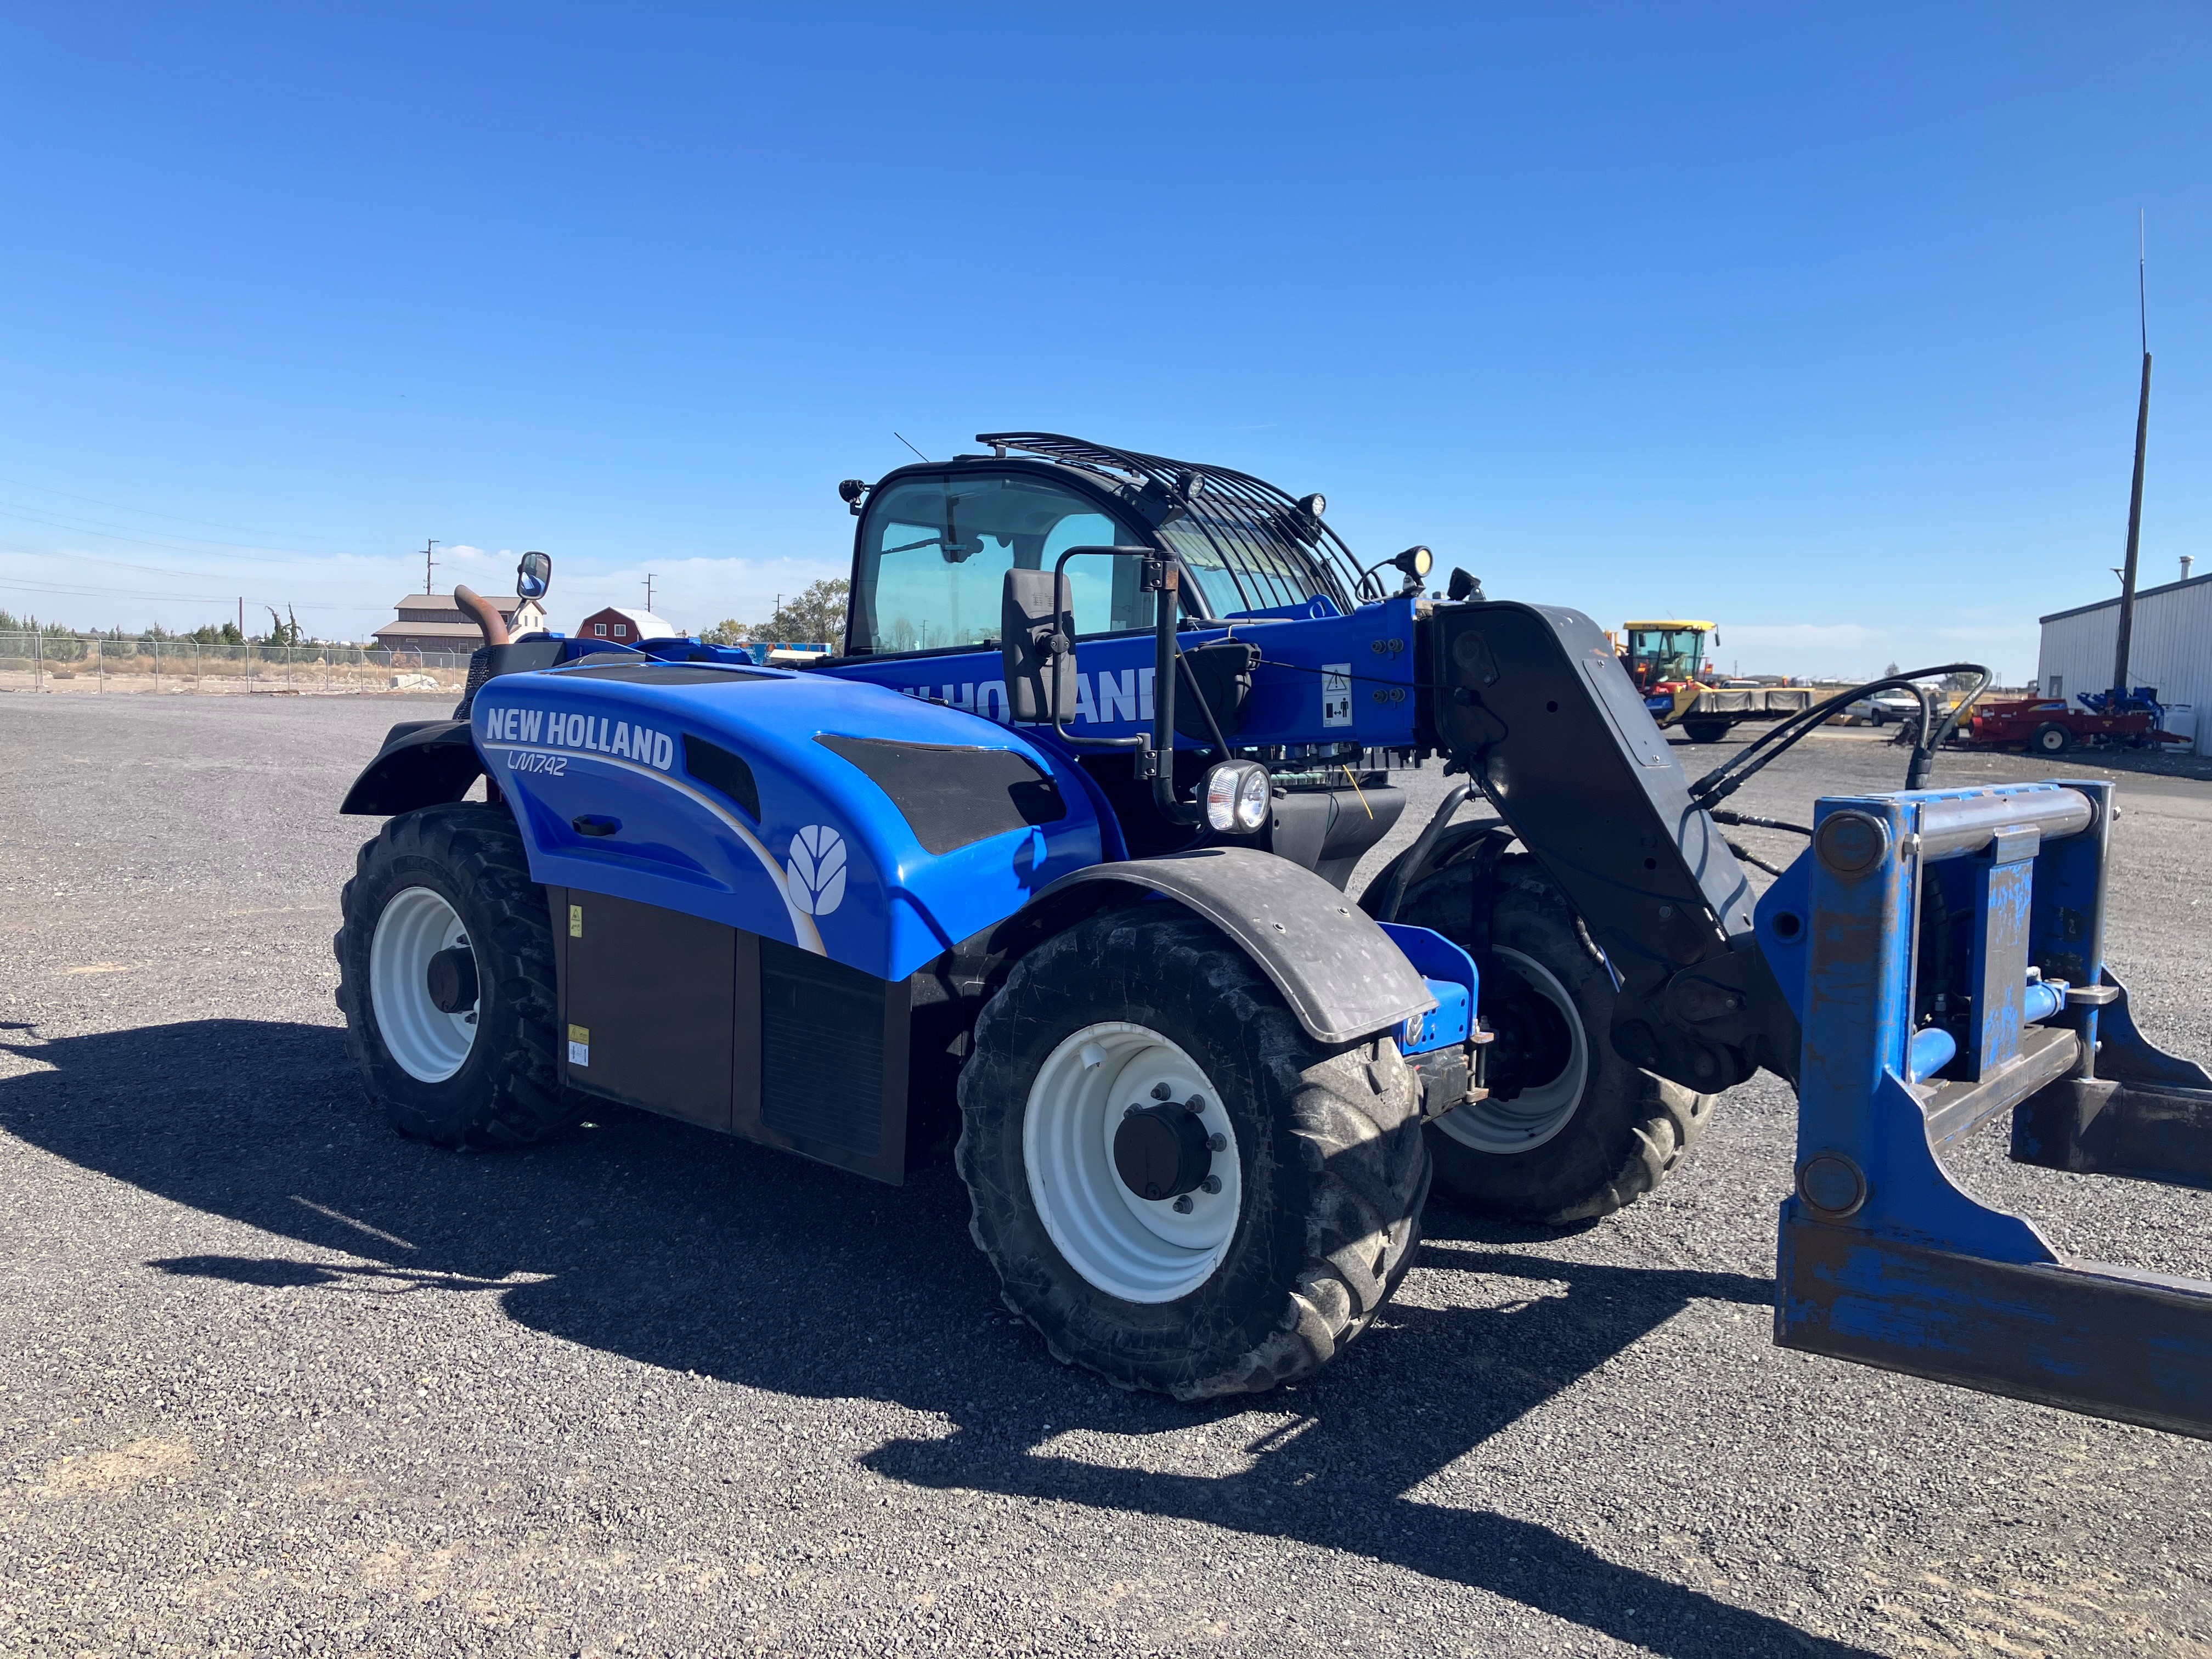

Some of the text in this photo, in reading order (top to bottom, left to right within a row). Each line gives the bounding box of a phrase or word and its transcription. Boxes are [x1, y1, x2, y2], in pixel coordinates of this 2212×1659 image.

[487, 708, 673, 771] NEW HOLLAND
[507, 751, 567, 776] LM7.42
